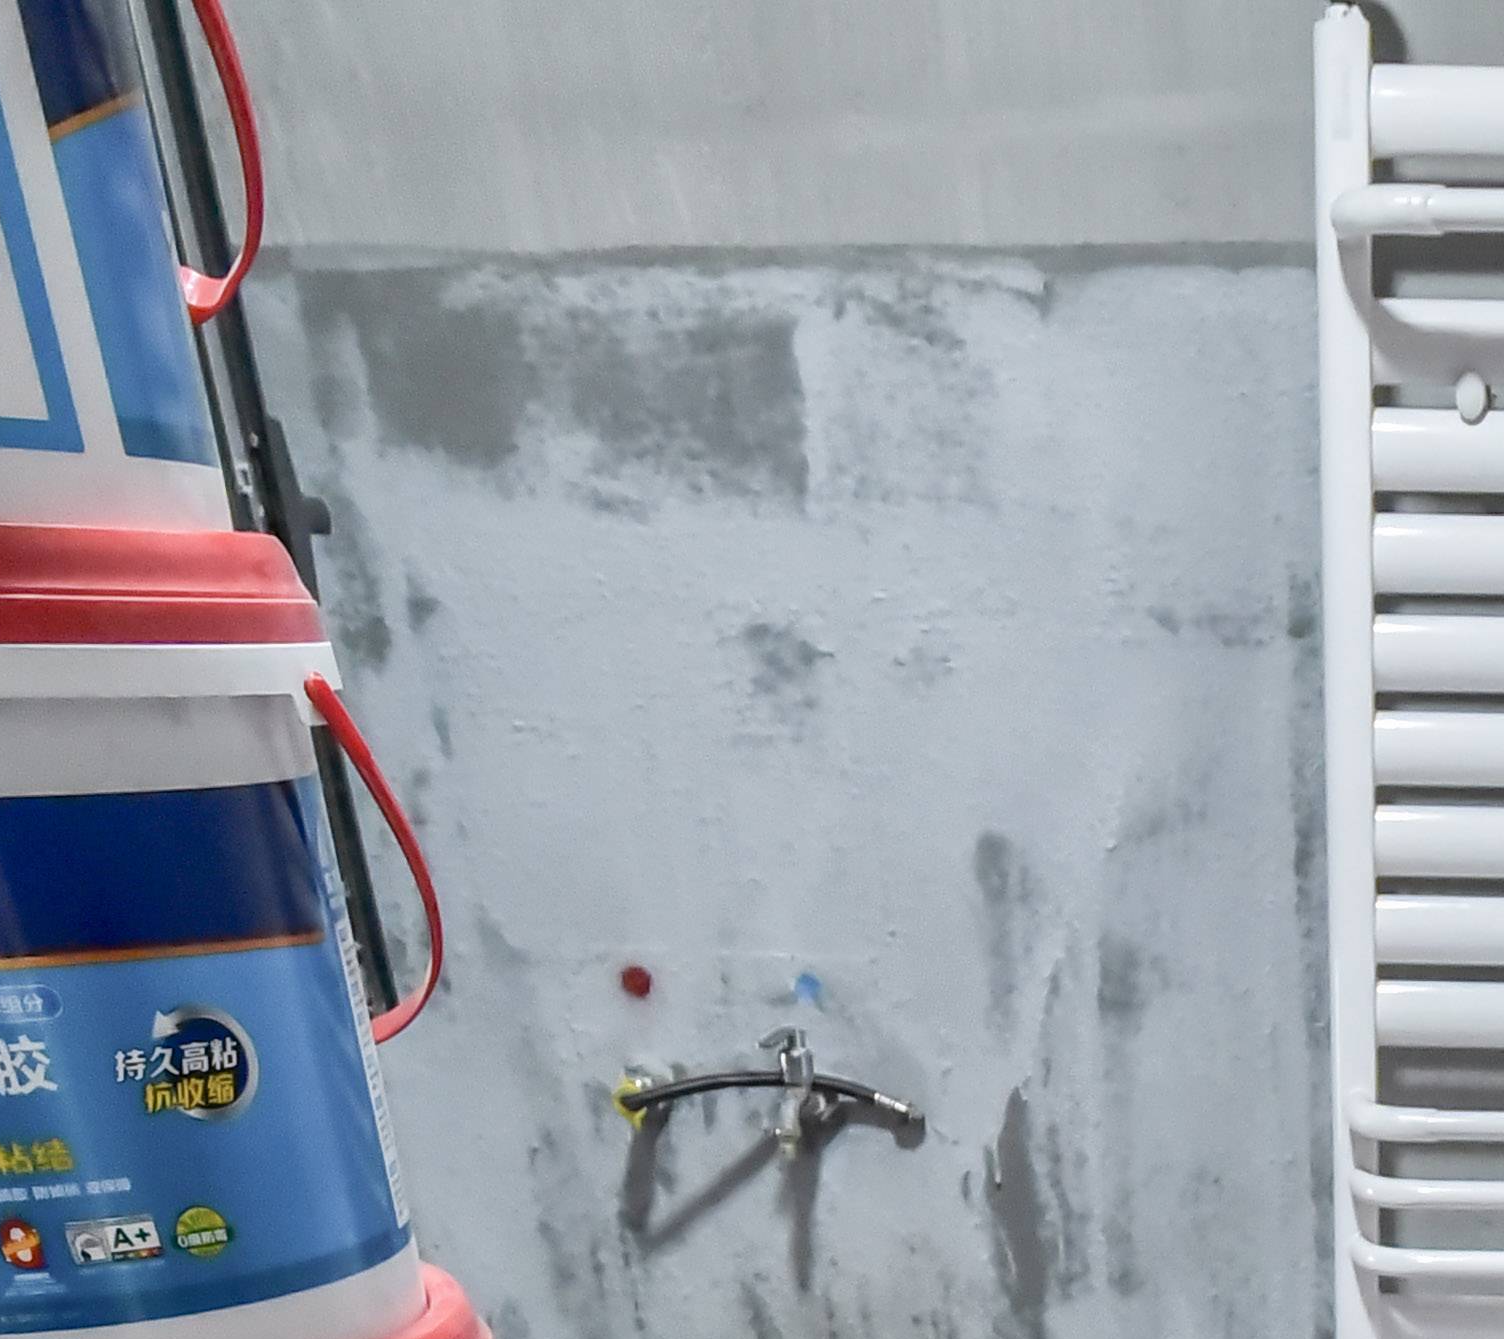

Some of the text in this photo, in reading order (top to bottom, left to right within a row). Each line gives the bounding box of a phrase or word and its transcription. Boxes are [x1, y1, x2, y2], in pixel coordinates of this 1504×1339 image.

[115, 1036, 238, 1083] 持久高粘
[144, 1073, 235, 1114] 抗收缩
[112, 1228, 152, 1249] A+
